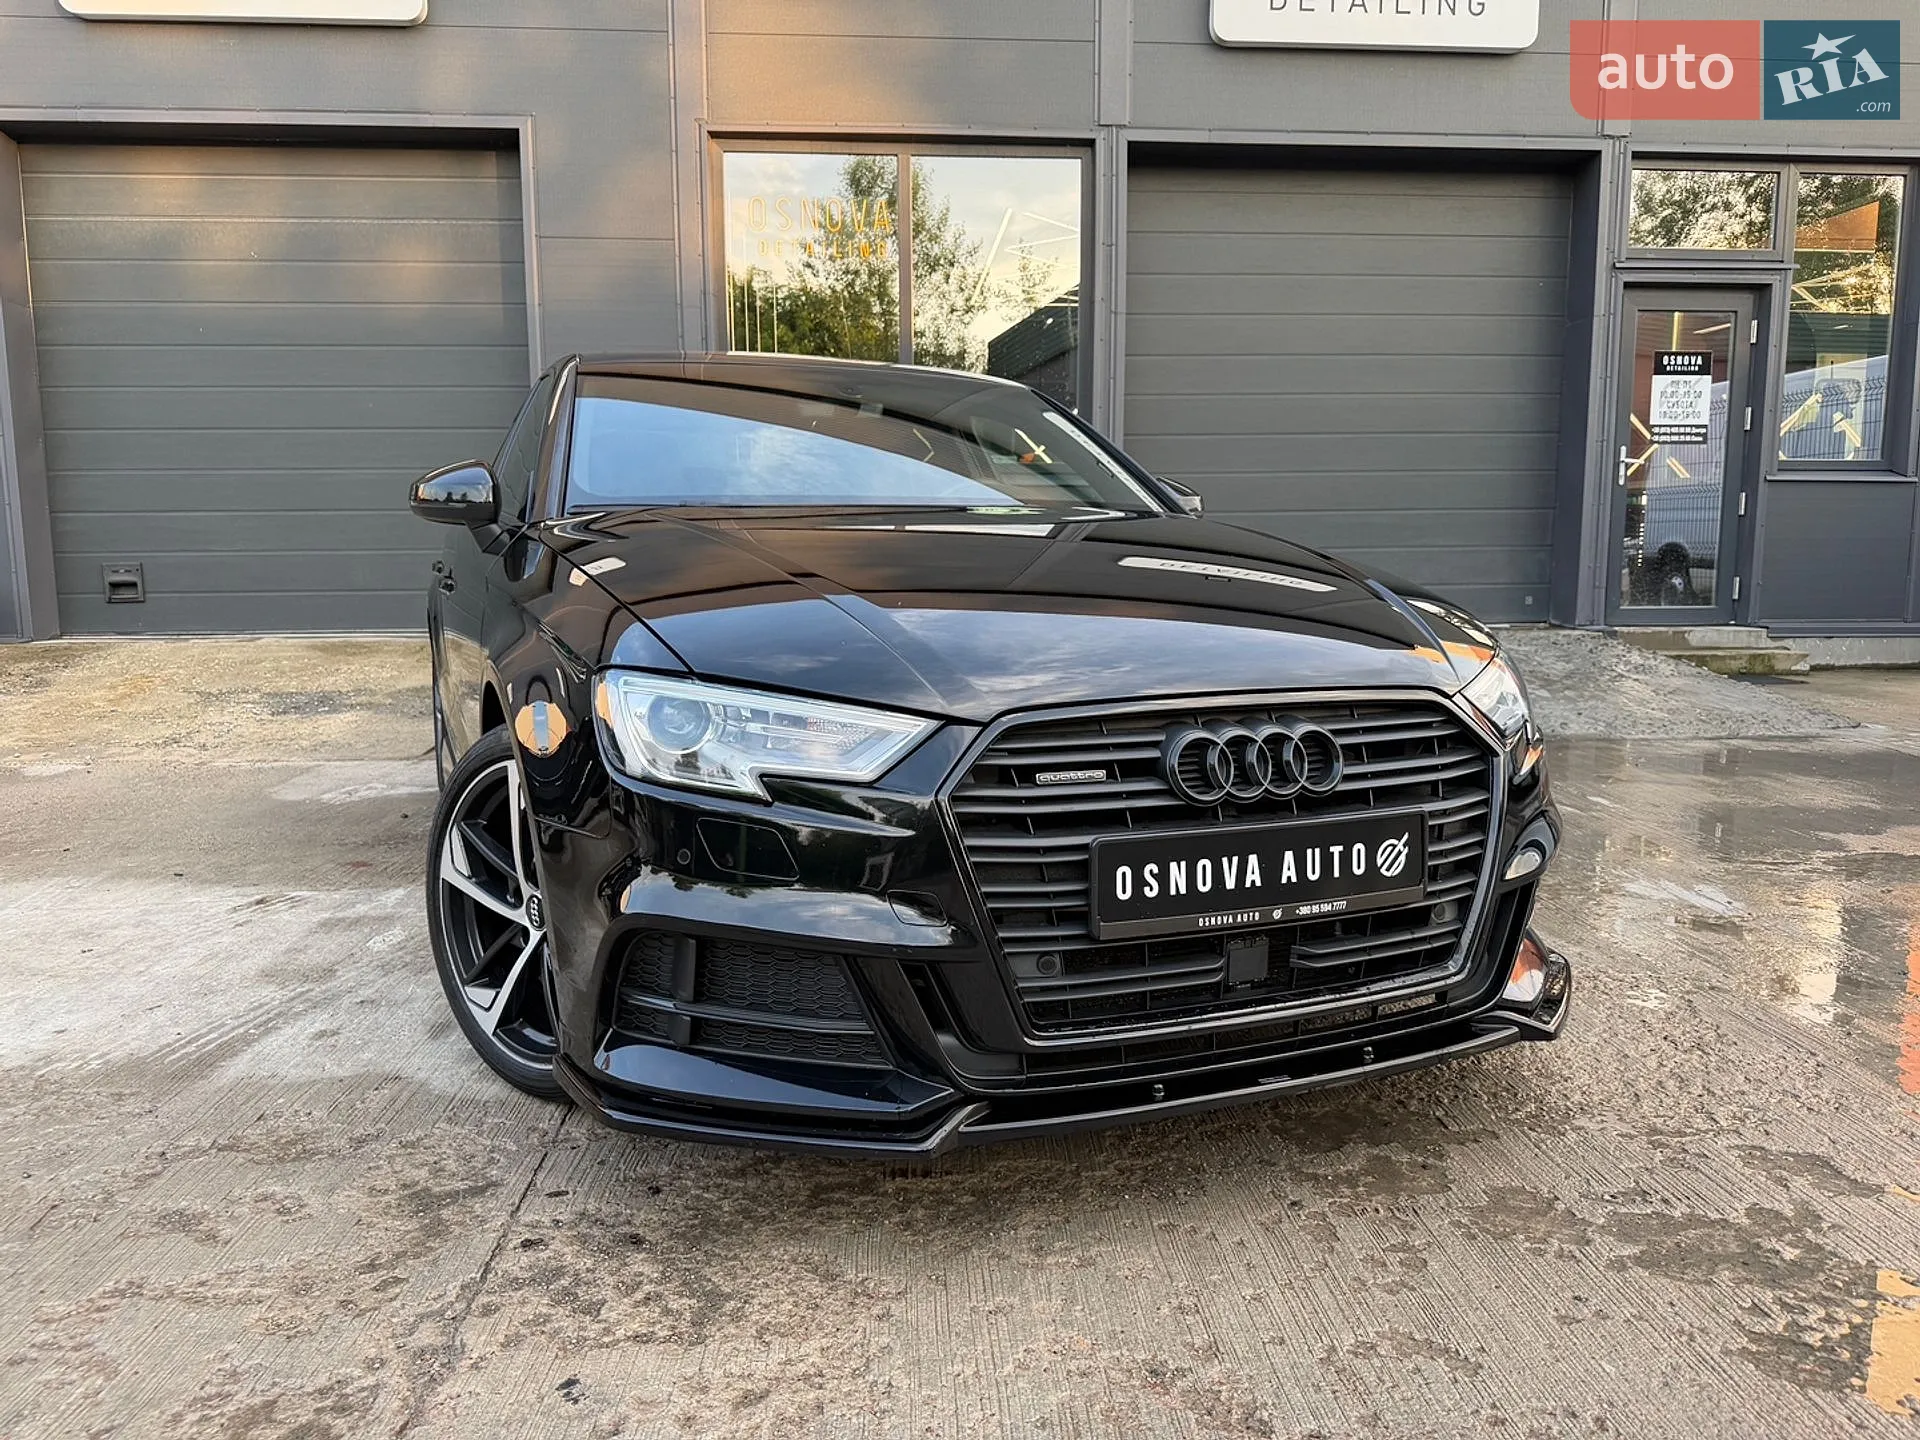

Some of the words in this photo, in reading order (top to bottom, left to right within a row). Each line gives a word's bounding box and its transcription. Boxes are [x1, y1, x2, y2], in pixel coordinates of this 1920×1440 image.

[748, 196, 890, 232] OSNOVA
[1662, 355, 1703, 366] OSNOVA
[1039, 771, 1104, 783] quattro
[1115, 853, 1262, 900] OSNOVA
[1280, 842, 1367, 884] AUTO
[1198, 914, 1234, 927] OSNOVA
[1237, 911, 1260, 922] AUTO
